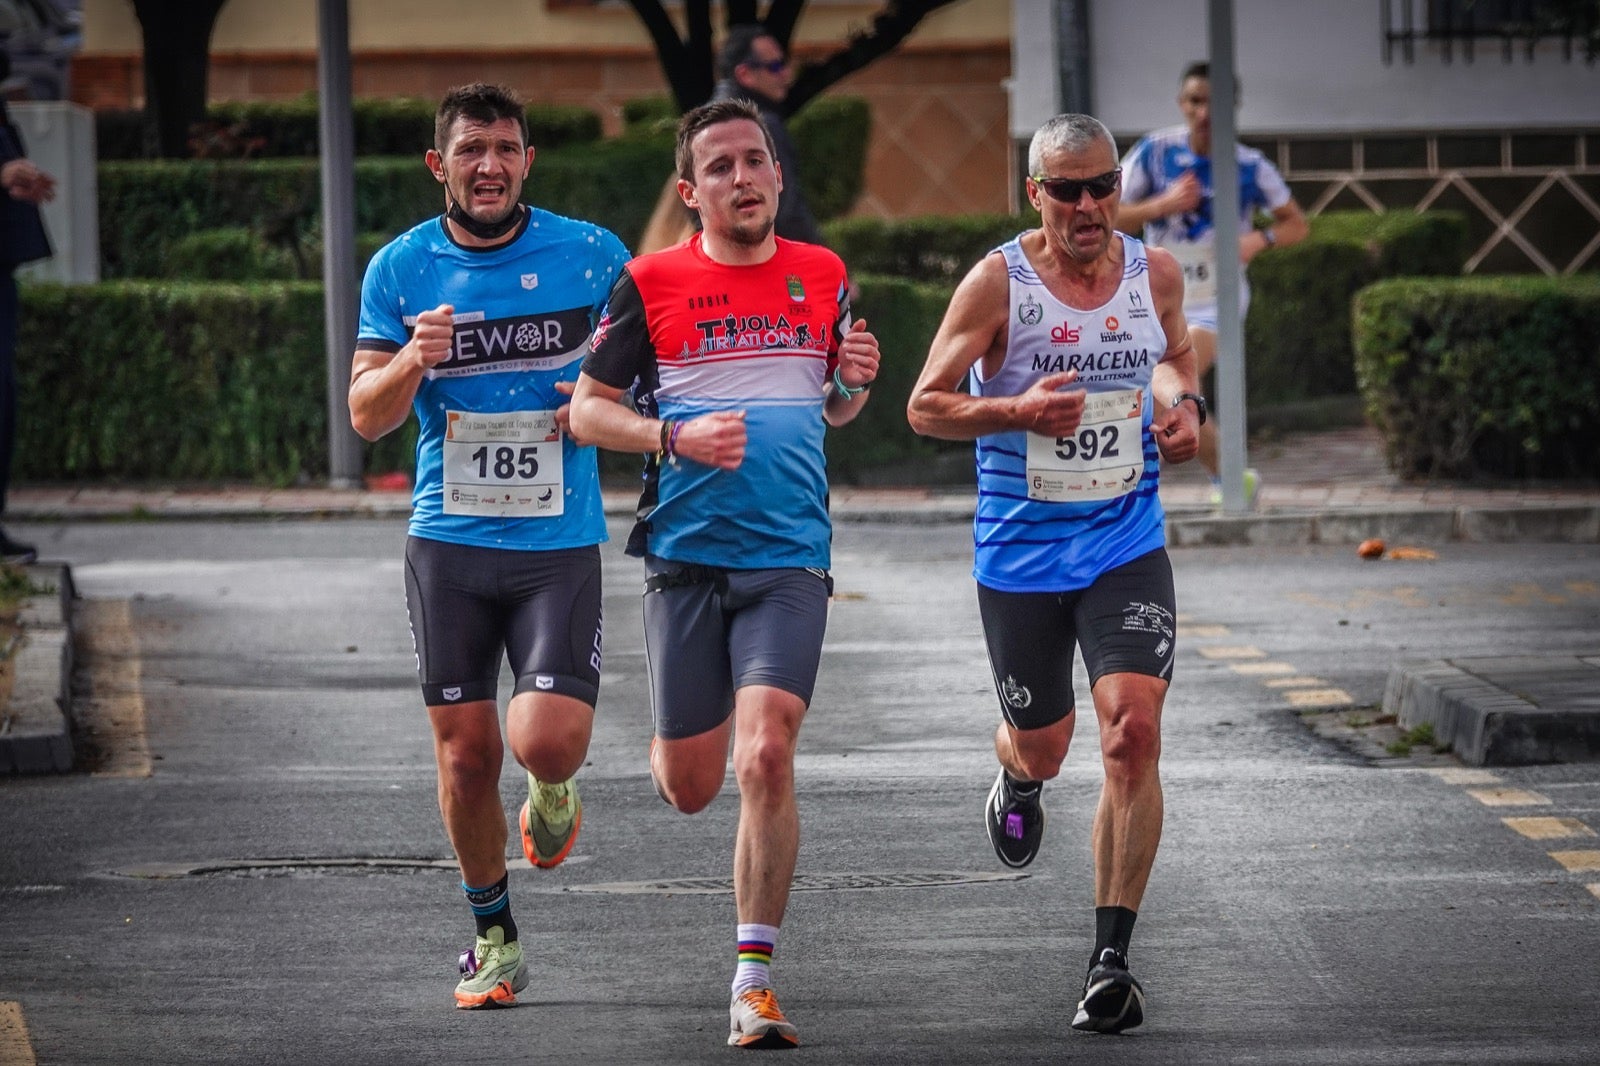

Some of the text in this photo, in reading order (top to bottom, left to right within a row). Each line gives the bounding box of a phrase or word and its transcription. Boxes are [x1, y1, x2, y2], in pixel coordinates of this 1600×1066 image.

[688, 294, 730, 310] GOBIK
[1051, 321, 1080, 343] als
[1101, 331, 1133, 344] mayfo
[1031, 347, 1149, 372] MARACENA
[1086, 372, 1136, 382] ATLETISMO
[1055, 425, 1119, 461] 592
[472, 446, 539, 480] 185
